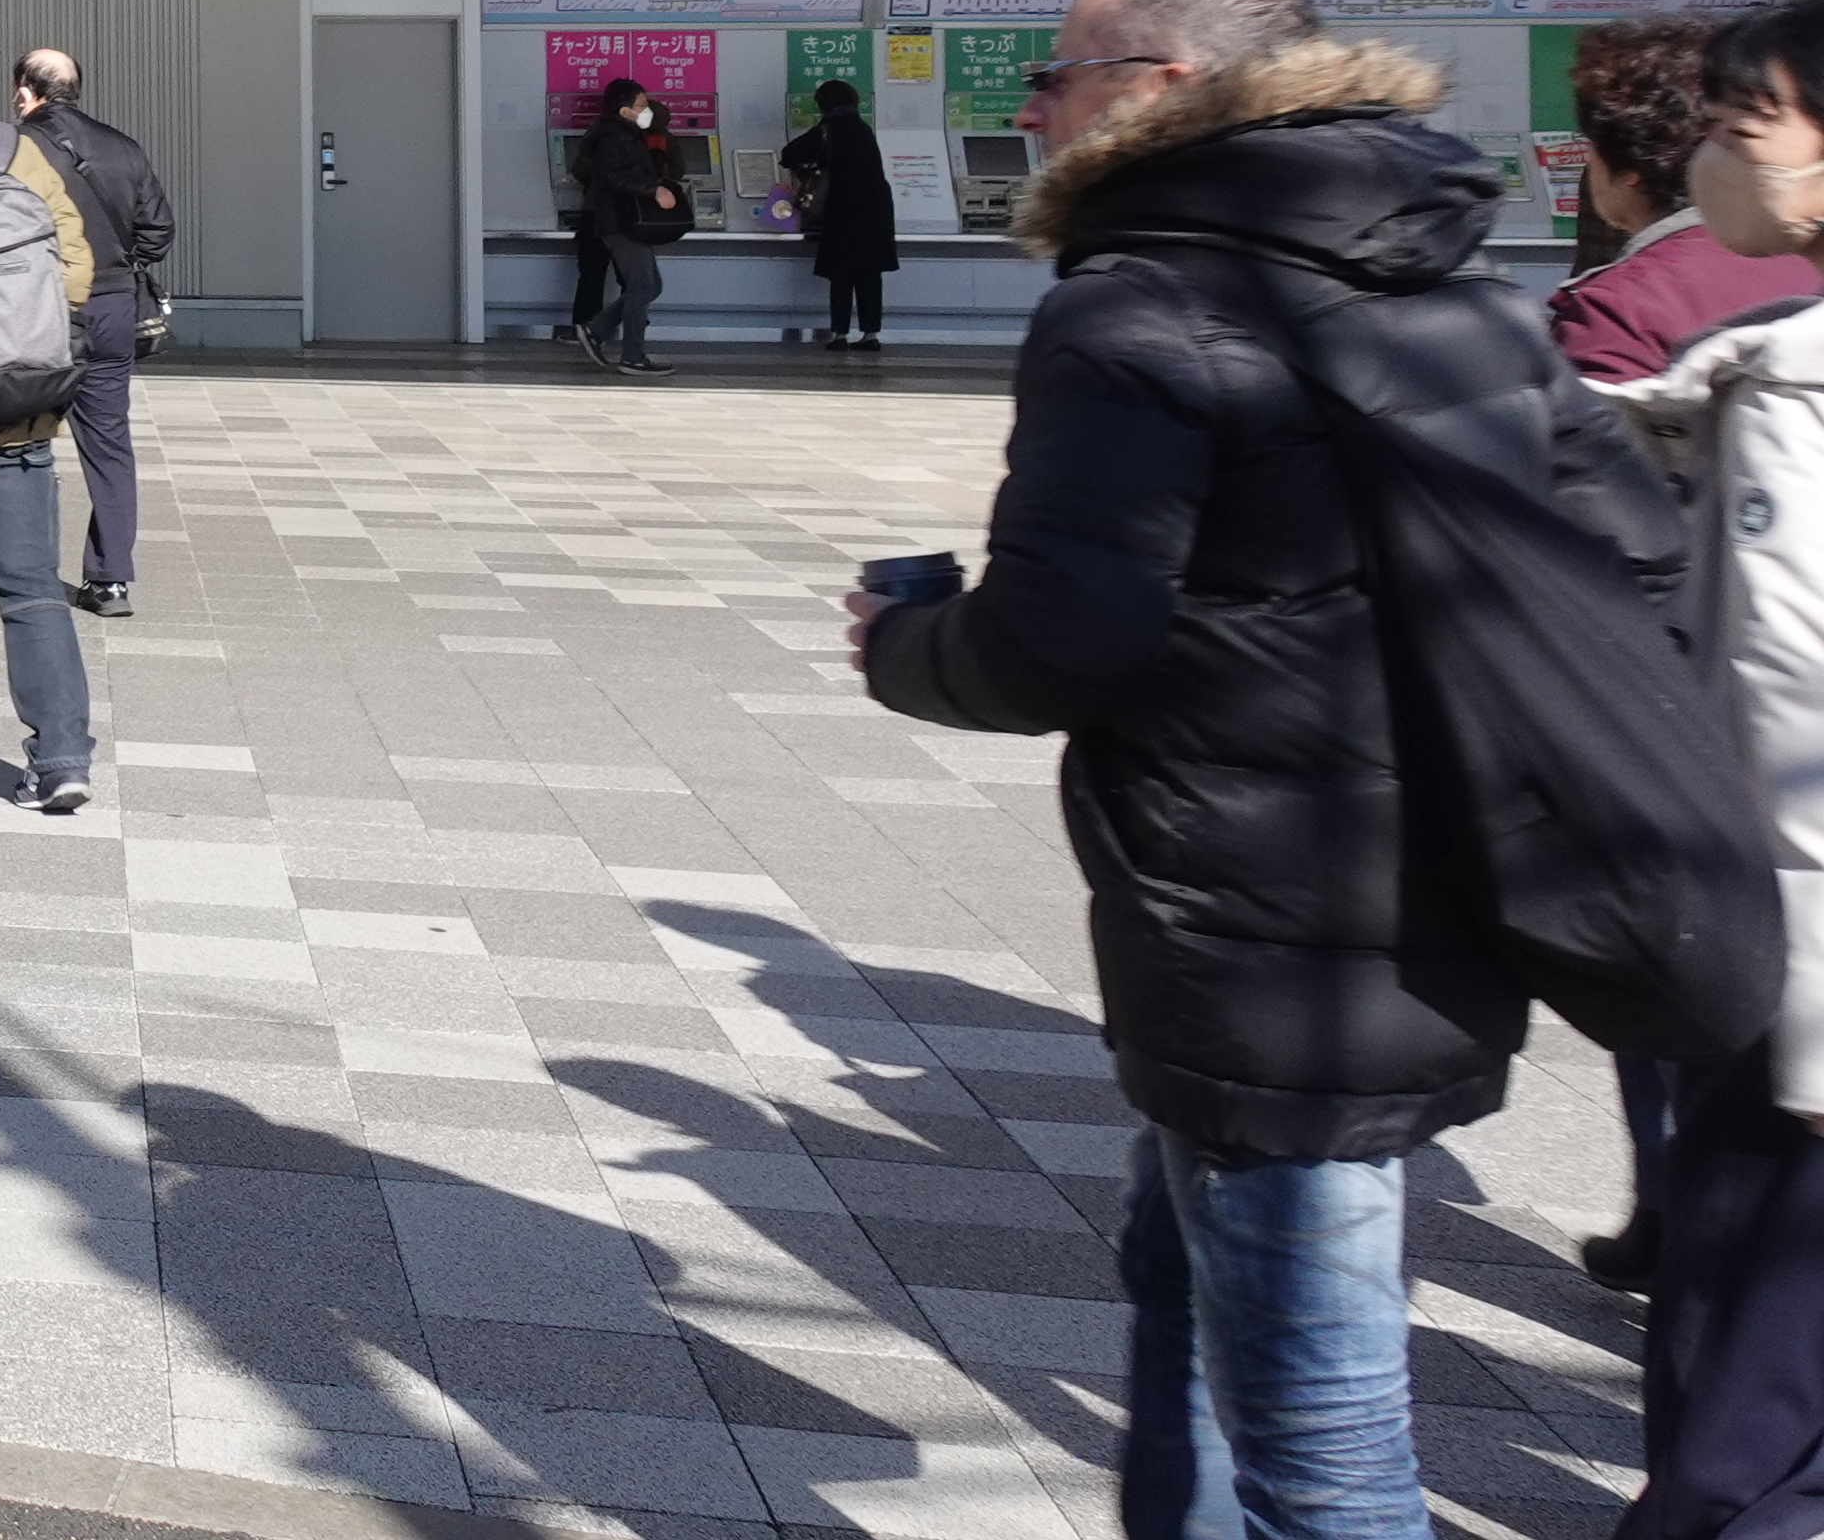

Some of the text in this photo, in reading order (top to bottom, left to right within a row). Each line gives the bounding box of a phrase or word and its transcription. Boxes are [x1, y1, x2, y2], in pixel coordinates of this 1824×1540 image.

[551, 35, 625, 55] チャージ専用
[636, 34, 711, 55] チャージ専用
[802, 34, 857, 53] きっぷ
[960, 33, 1016, 53] きっぷ
[567, 56, 609, 67] Charge
[652, 55, 694, 66] Charge
[809, 55, 851, 64] Tickets
[967, 55, 1010, 64] Tickets
